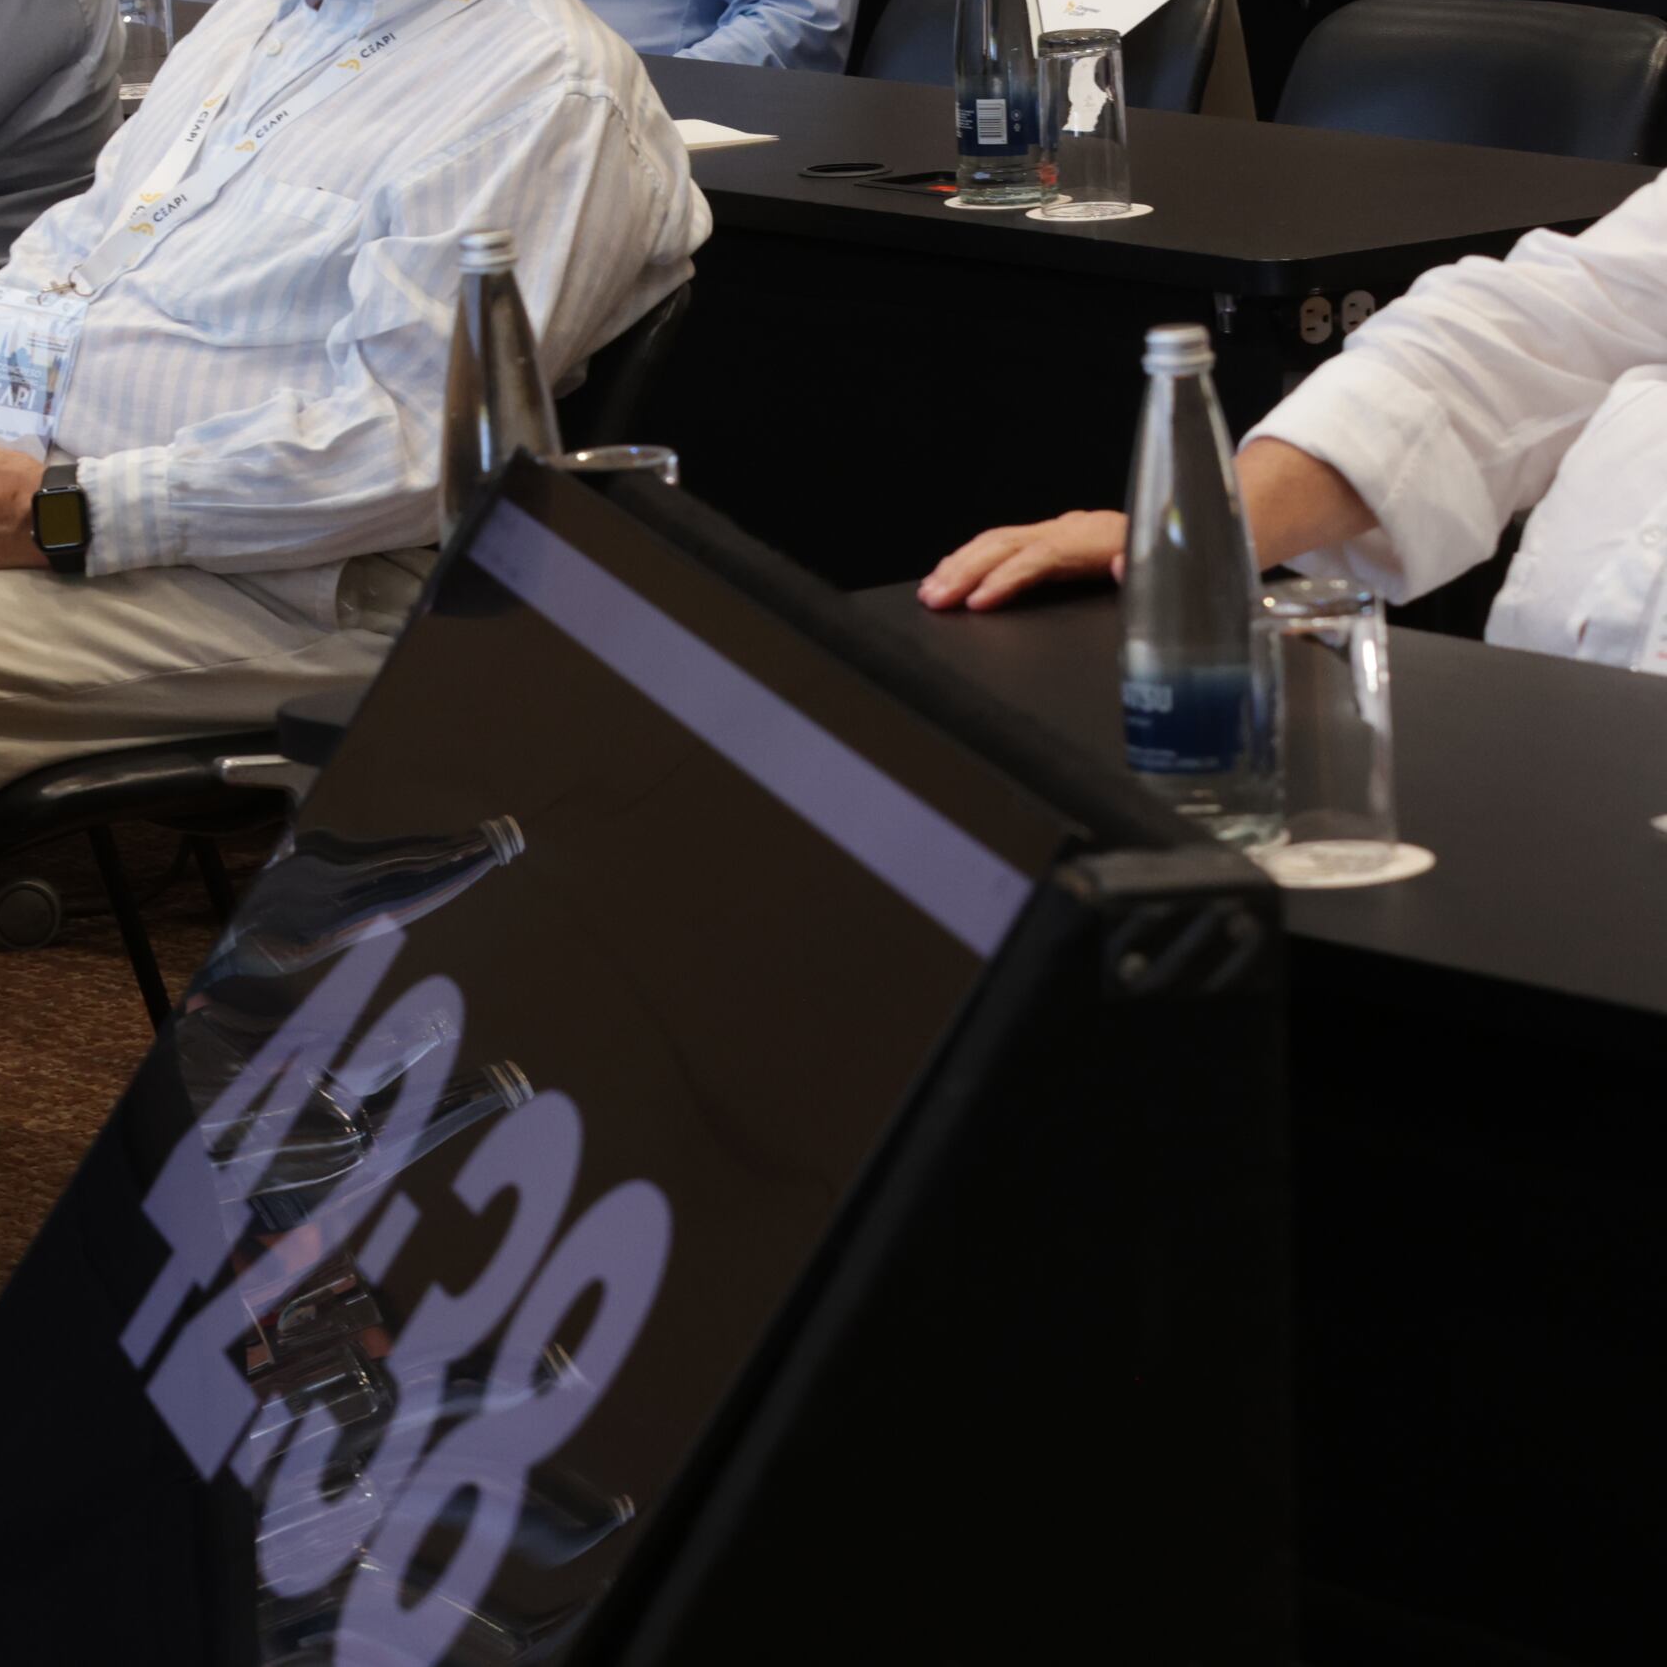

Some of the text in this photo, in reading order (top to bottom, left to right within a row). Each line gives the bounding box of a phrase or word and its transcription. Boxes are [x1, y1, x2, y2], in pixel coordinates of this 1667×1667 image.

[359, 31, 397, 60] CEAPI
[185, 110, 210, 143] CEAPI
[254, 110, 290, 140] CEAPI
[153, 193, 189, 223] CEAPI
[121, 914, 672, 1667] 42:38
